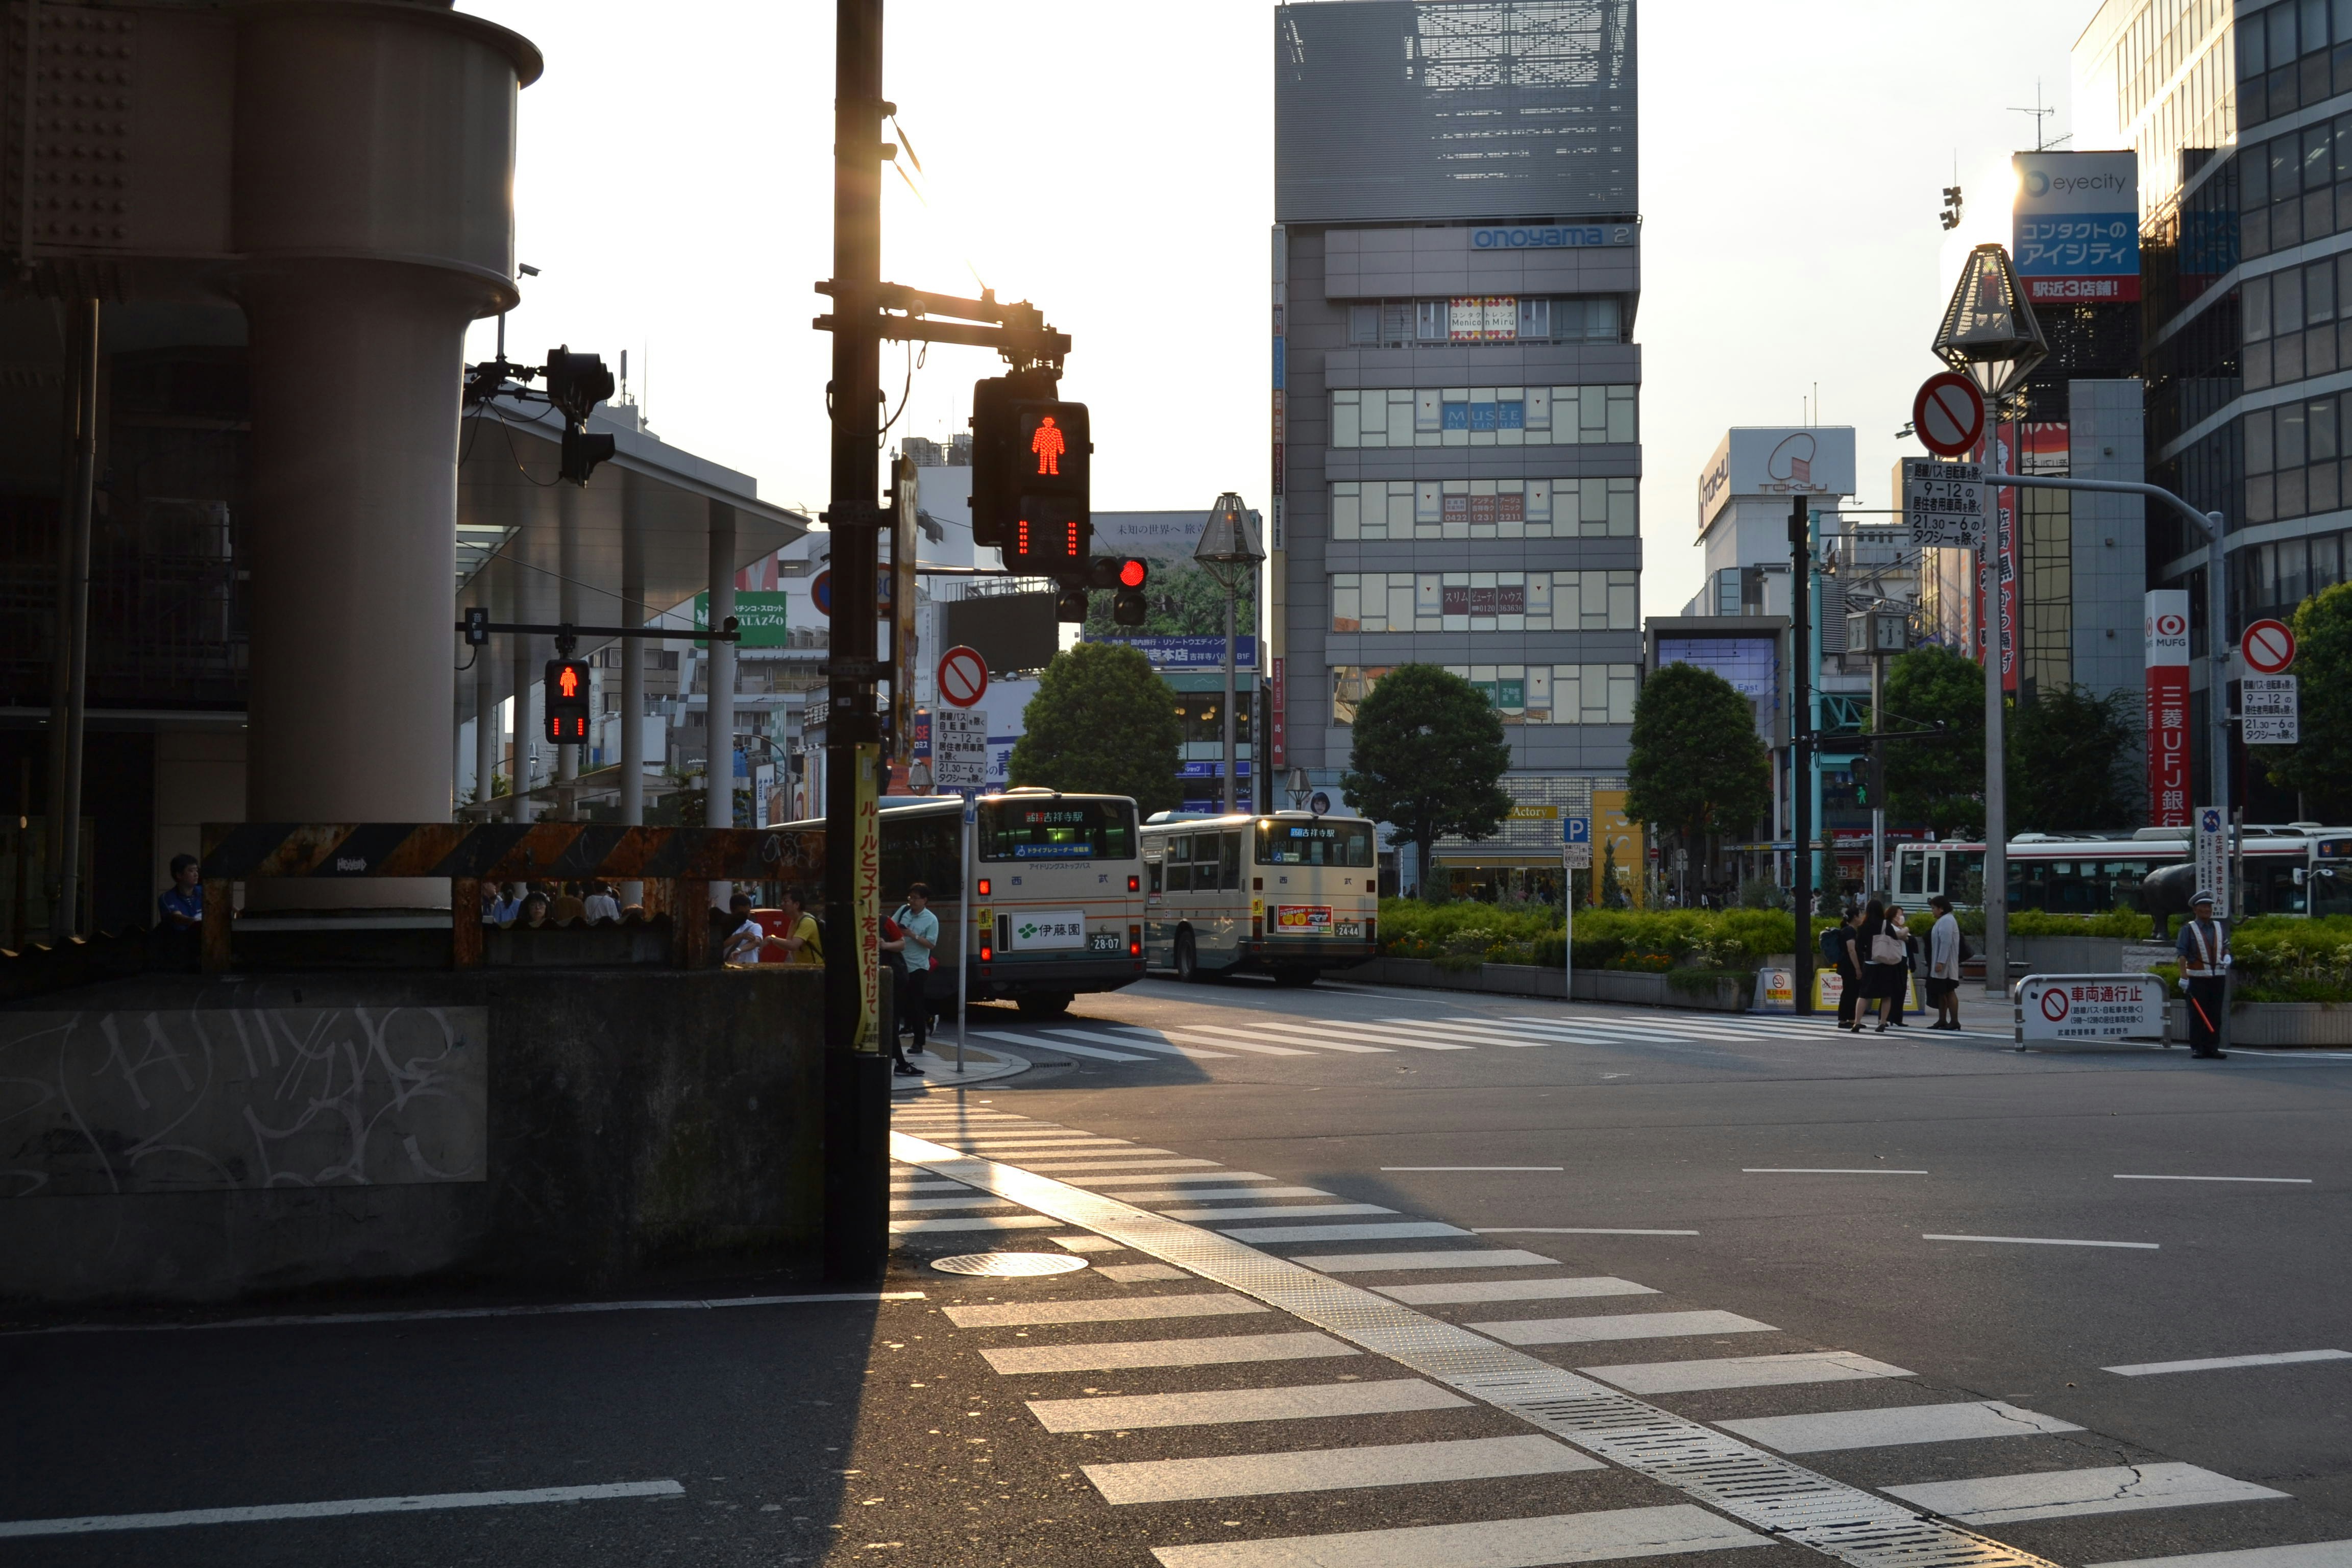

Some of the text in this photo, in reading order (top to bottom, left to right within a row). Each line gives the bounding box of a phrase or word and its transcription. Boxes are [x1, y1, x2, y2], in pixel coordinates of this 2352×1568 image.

[2053, 173, 2125, 194] eyecity
[2022, 222, 2127, 239] コンタクトの
[1475, 228, 1630, 247] onoyama 2
[2022, 243, 2126, 265] アイシティ
[2032, 281, 2118, 297] 駅近3店舗!
[1915, 463, 1982, 480] 路線バス・自転車を除く
[1758, 483, 1827, 492] TOKYU
[1913, 496, 1981, 512] 居住者用車両を除く
[1117, 524, 1181, 534] 未知の世界へ
[1914, 530, 1978, 546] タクシーを除く
[738, 615, 784, 626] ALAZZO
[2245, 705, 2294, 714] 居住者用車両を除く
[940, 712, 984, 726] 路線バス を除く
[940, 722, 966, 730] 自転車
[2246, 730, 2294, 739] タクシーを除く
[939, 743, 984, 752] 居住者用車両
[939, 752, 957, 761] を除く
[2161, 686, 2184, 826] 三菱UFJ銀行
[939, 774, 983, 783] タクシーを除く
[1044, 812, 1083, 822] 吉祥寺駅
[1511, 806, 1547, 818] Actory
[1303, 829, 1335, 837] 吉祥寺駅
[1570, 820, 1584, 840] P
[2215, 835, 2223, 905] 左折できません
[1012, 874, 1108, 885] 西 武
[860, 801, 877, 1014] ルールとマナーを身に付けて
[1039, 923, 1080, 936] 伊藤園
[2071, 986, 2142, 1002] 車両通行止
